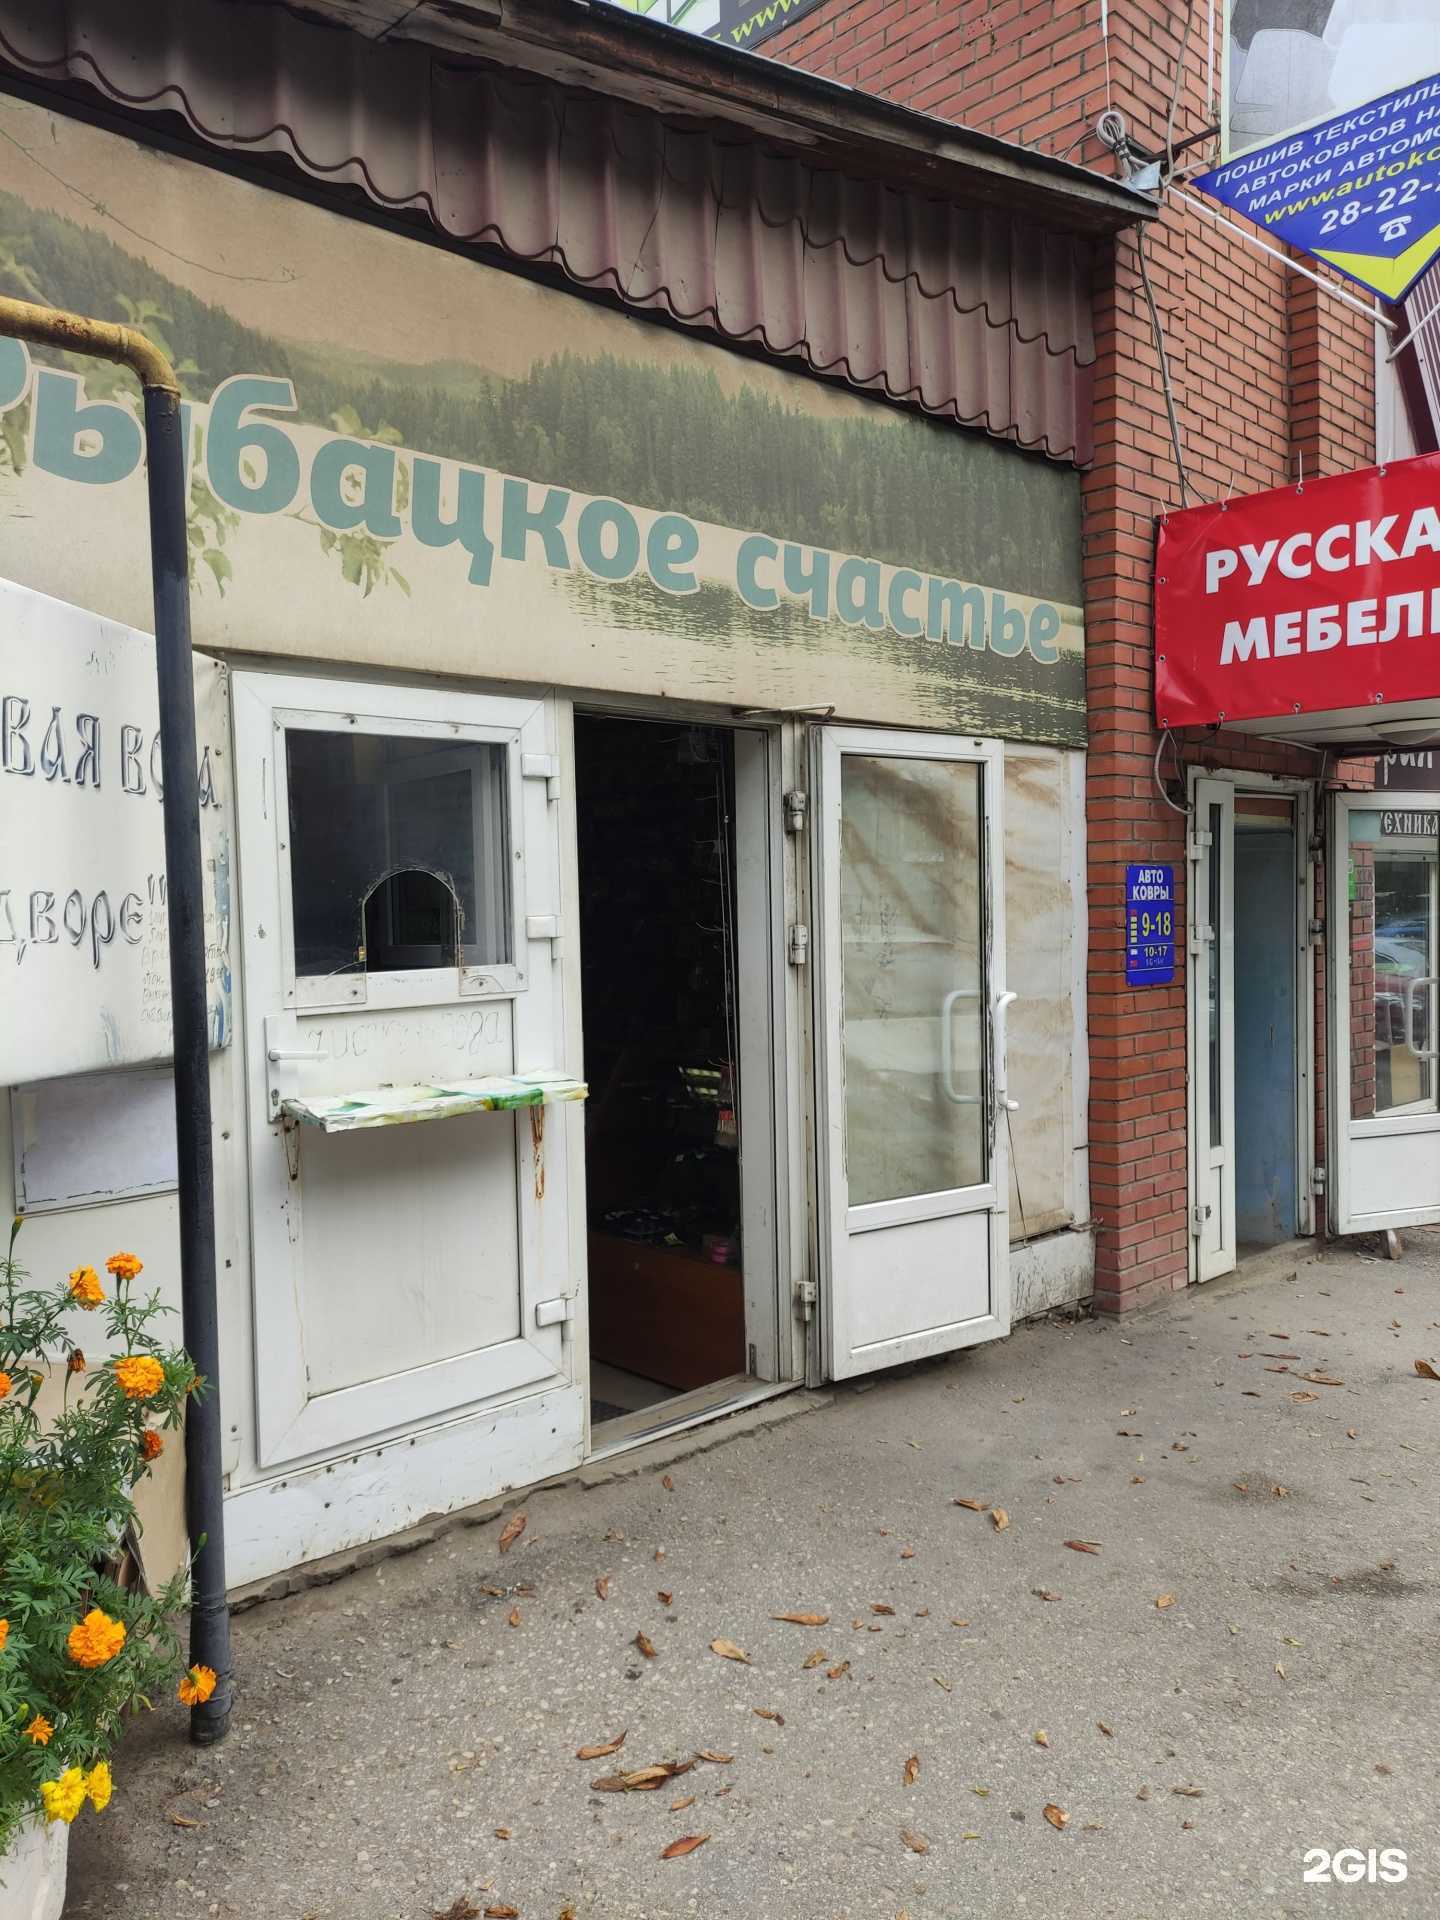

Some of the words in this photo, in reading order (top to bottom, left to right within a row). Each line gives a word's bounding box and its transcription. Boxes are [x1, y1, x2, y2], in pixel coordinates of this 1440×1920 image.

[1215, 141, 1303, 188] ПОШИВ
[1234, 118, 1406, 198] АВТОКОВРОВ
[1416, 105, 1440, 125] Н
[1248, 170, 1331, 212] МАРКИ
[1319, 170, 1440, 235] 28-22-
[0, 336, 699, 592] ыбацкое
[737, 535, 1061, 664] счастье
[1206, 506, 1440, 594] РУССКА
[120, 722, 222, 808] ВОА
[1380, 811, 1439, 835] ЕХНИКА
[1133, 885, 1169, 900] КОВРЫ
[1138, 870, 1164, 883] АВТО
[1142, 912, 1171, 936] 9-18
[1144, 946, 1168, 957] 10-17
